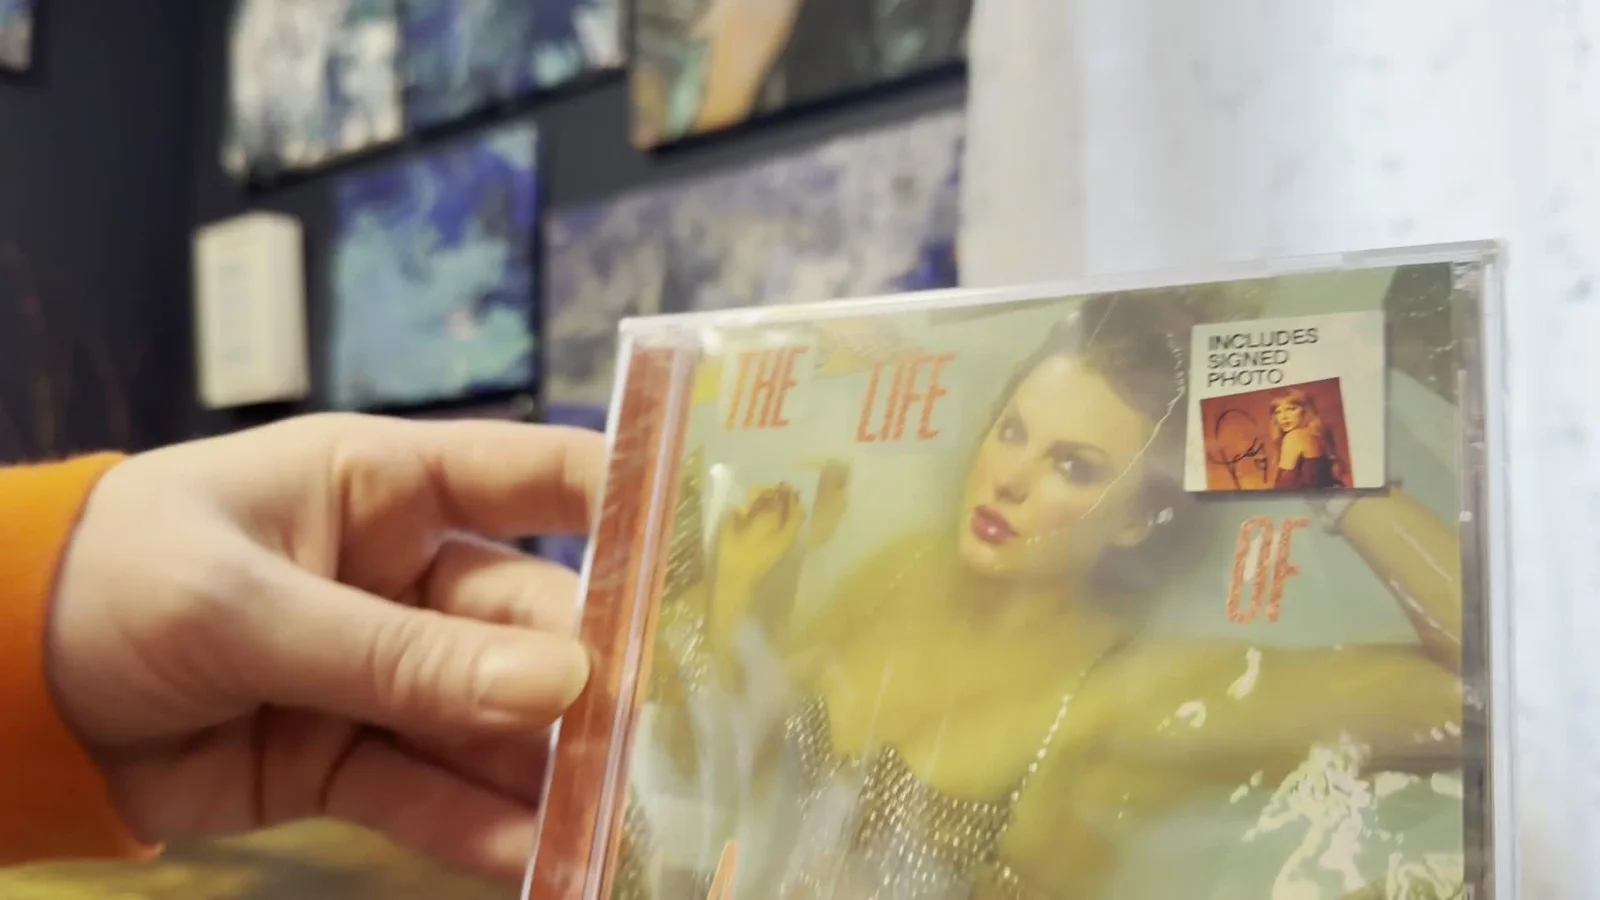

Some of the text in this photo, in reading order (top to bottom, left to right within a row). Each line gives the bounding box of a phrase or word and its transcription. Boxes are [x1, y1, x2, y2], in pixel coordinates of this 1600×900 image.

[1208, 327, 1319, 351] INCLUDES
[1207, 350, 1290, 370] SIGNED
[1207, 368, 1284, 388] PHOTO
[725, 345, 957, 442] THE LIFE
[1226, 514, 1311, 625] OF
